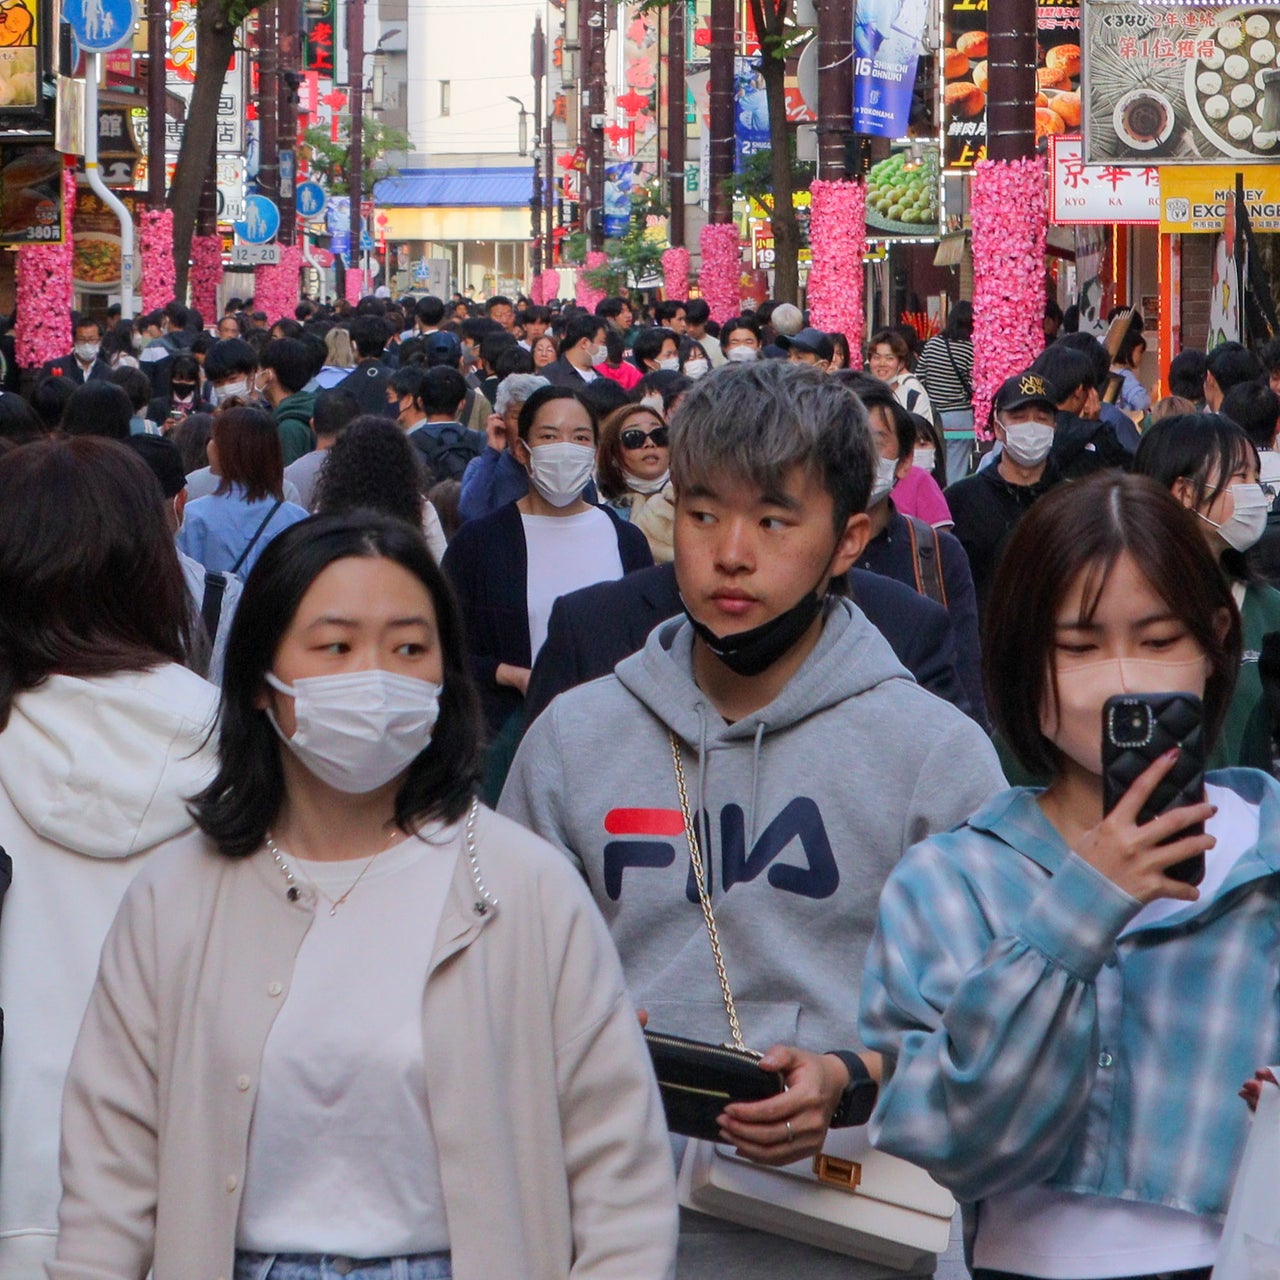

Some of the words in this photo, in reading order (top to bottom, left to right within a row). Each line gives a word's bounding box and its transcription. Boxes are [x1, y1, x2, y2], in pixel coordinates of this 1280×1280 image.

[1153, 12, 1216, 28] 2年連続
[1119, 36, 1216, 59] 第1位獲得
[855, 57, 873, 76] 16
[872, 68, 902, 82] OHNUKI
[860, 107, 895, 119] YOKOHAMA
[742, 141, 751, 154] 2
[1065, 198, 1086, 207] KYO
[1108, 198, 1123, 207] KA
[27, 225, 60, 240] 380円
[235, 249, 275, 261] 12-20
[603, 796, 840, 904] FILA
